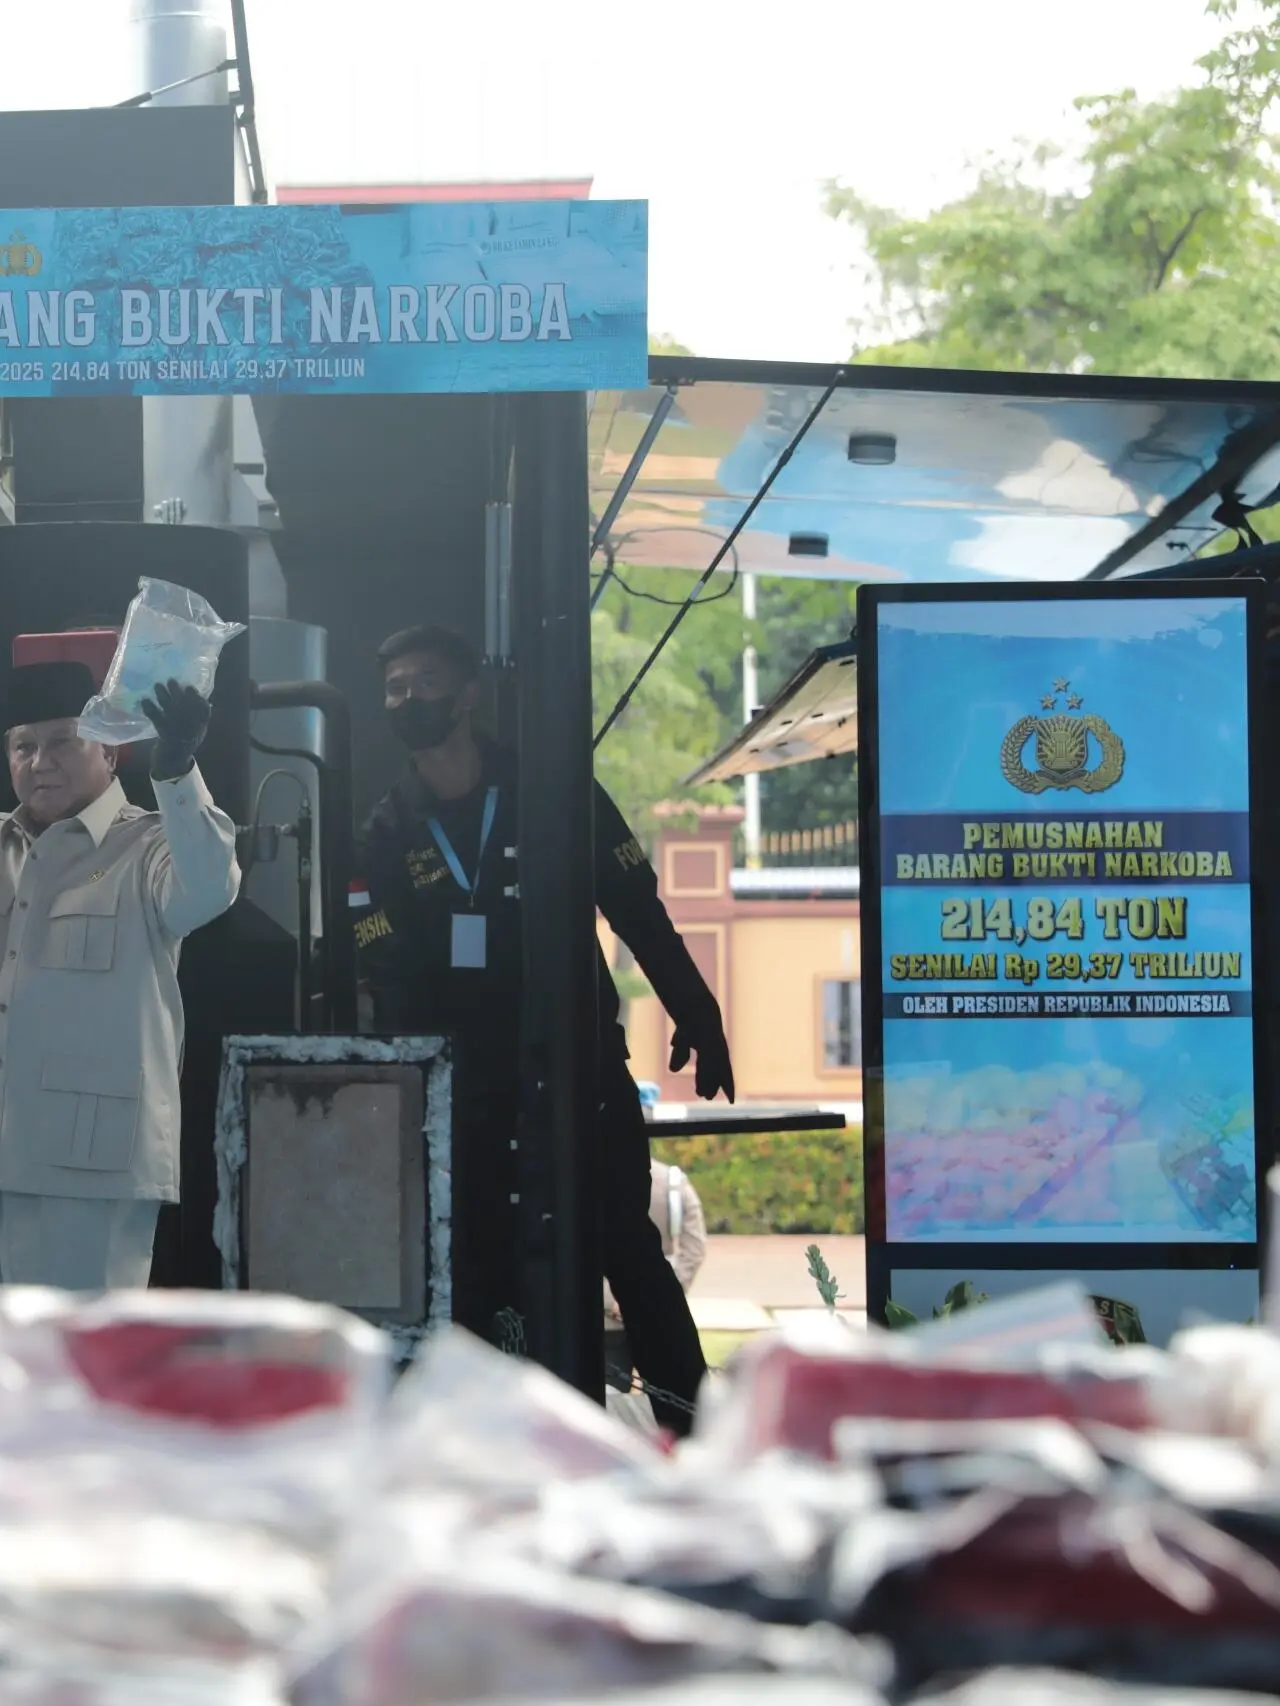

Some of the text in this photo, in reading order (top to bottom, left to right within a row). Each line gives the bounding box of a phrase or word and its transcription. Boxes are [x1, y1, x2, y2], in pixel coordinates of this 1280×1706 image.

[120, 285, 284, 347] BUKTI
[308, 282, 573, 345] NARKOBA
[0, 362, 44, 381] 2025
[117, 361, 151, 380] TON
[157, 360, 229, 380] SENILAI
[294, 358, 366, 378] TRILIUN
[962, 820, 1164, 850] PEMUSNAHAN
[896, 850, 1233, 879] BARANG BUKTI NARKOBA
[939, 894, 1189, 945] 214,84 TON
[889, 950, 1241, 985] SENILAI Rp 29,37 TRILIUN
[902, 994, 1231, 1014] OLEH PRESIDEN REPUBLIK INDONESIA
